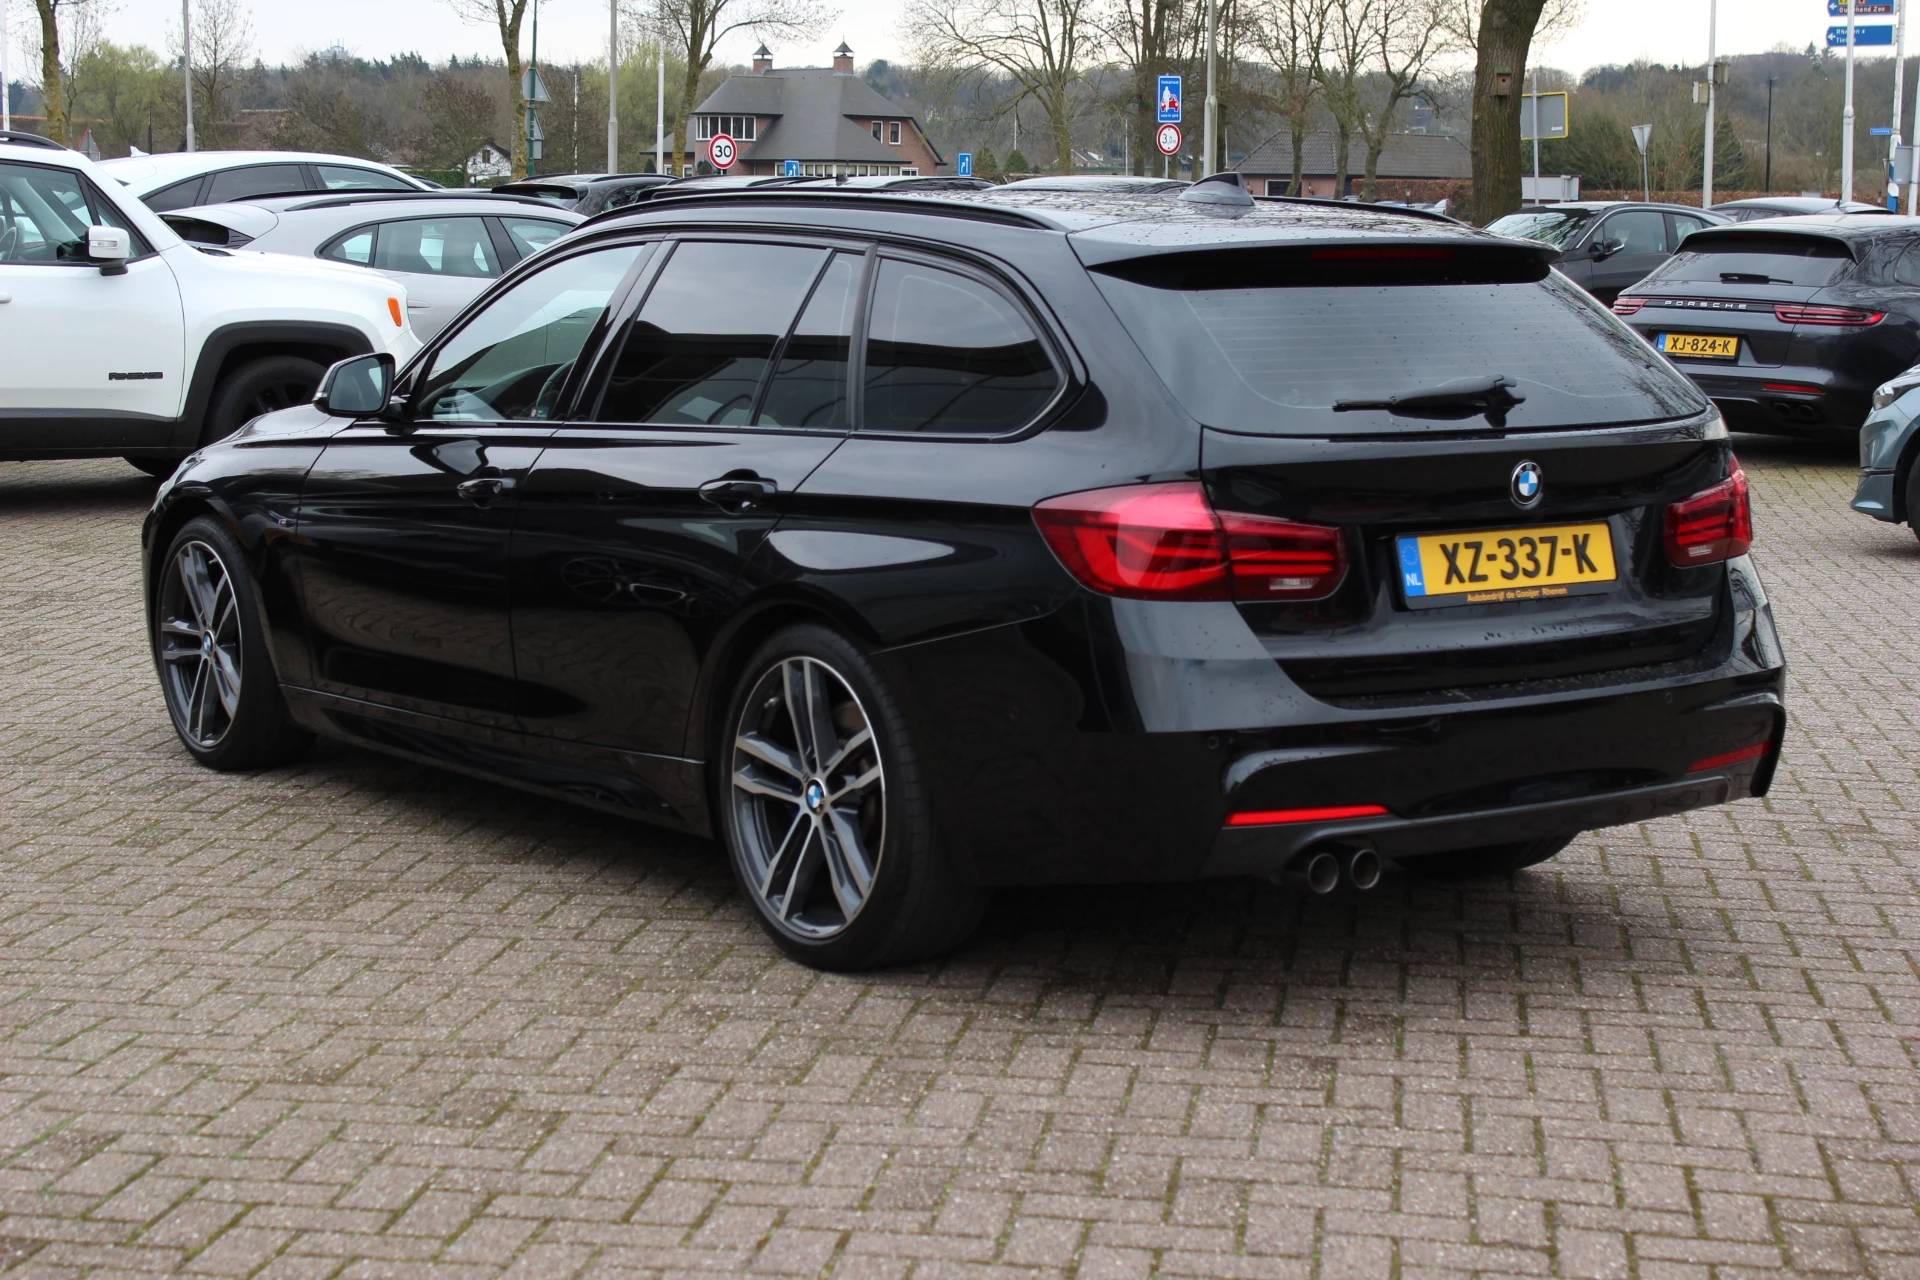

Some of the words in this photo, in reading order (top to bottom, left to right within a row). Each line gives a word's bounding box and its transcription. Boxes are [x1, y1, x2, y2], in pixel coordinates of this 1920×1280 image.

[715, 145, 732, 158] 30
[1664, 300, 1747, 309] PORSCHE
[1670, 337, 1731, 353] XJ-824-K
[1439, 534, 1598, 585] XZ-337-K
[1406, 573, 1422, 586] NL
[1467, 591, 1505, 602] Autobedrijf
[1506, 591, 1515, 599] de
[1542, 587, 1567, 595] Rhenen
